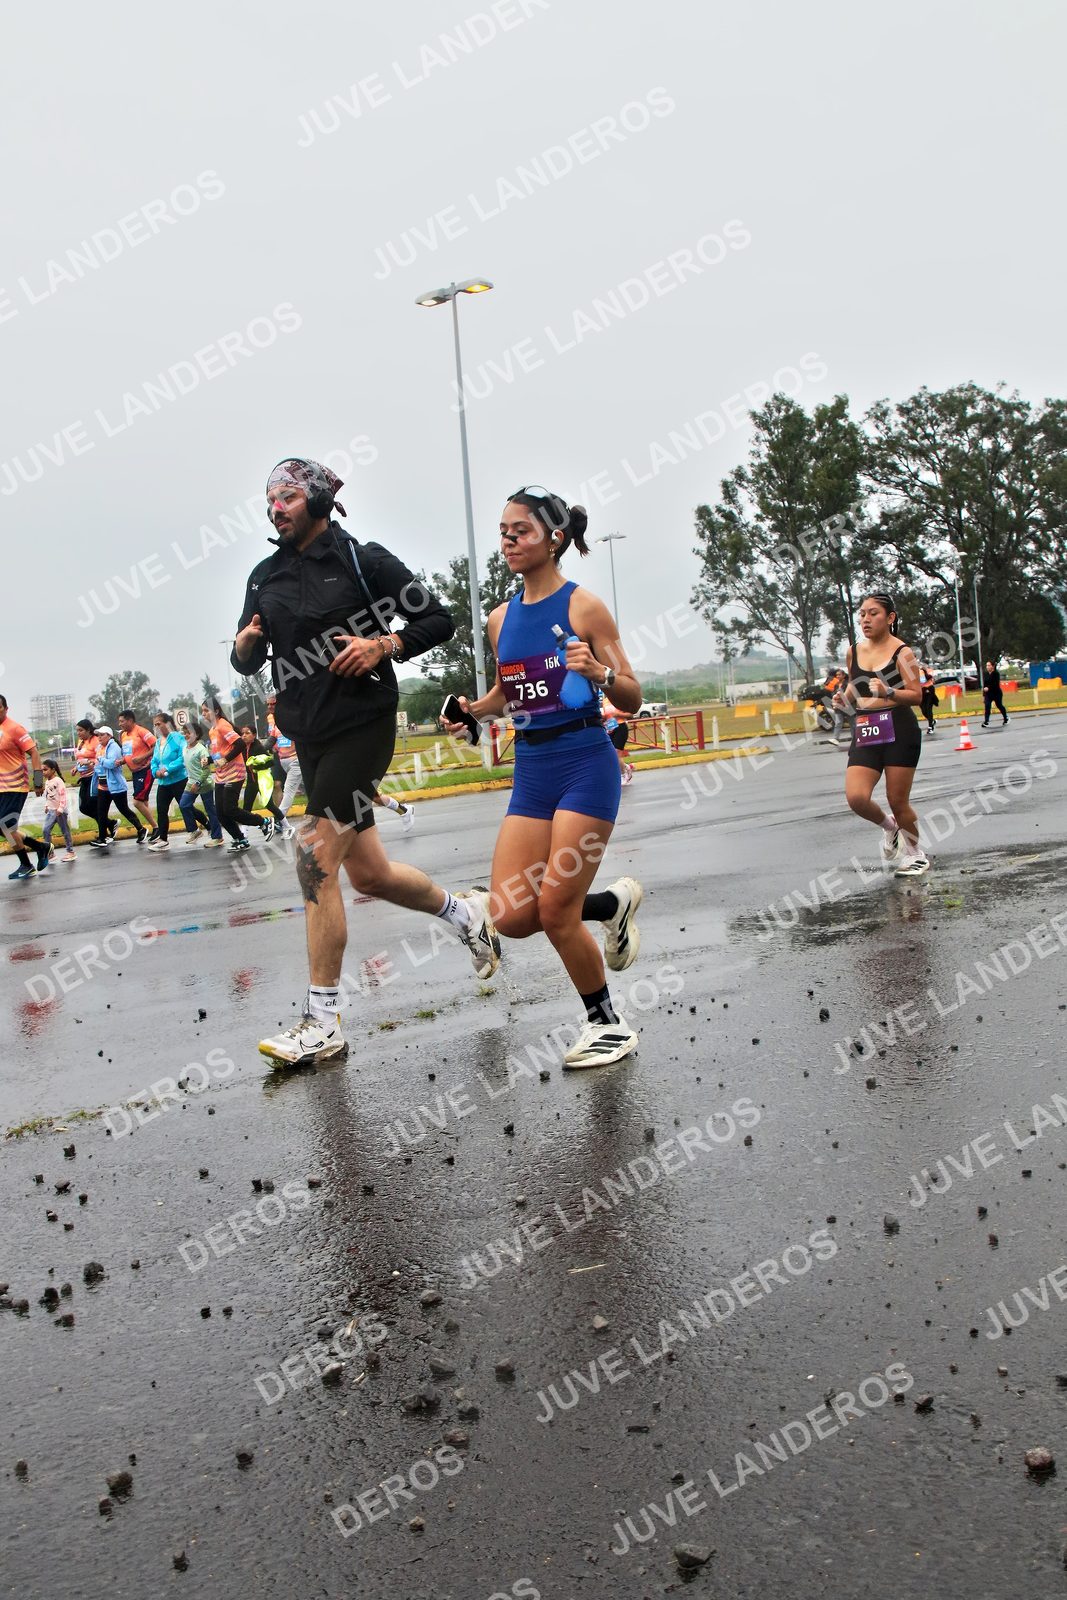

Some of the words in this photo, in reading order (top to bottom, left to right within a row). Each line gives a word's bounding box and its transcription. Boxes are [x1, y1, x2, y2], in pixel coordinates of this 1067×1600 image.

[544, 655, 560, 670] 15K
[515, 680, 549, 701] 736
[861, 726, 880, 737] 570
